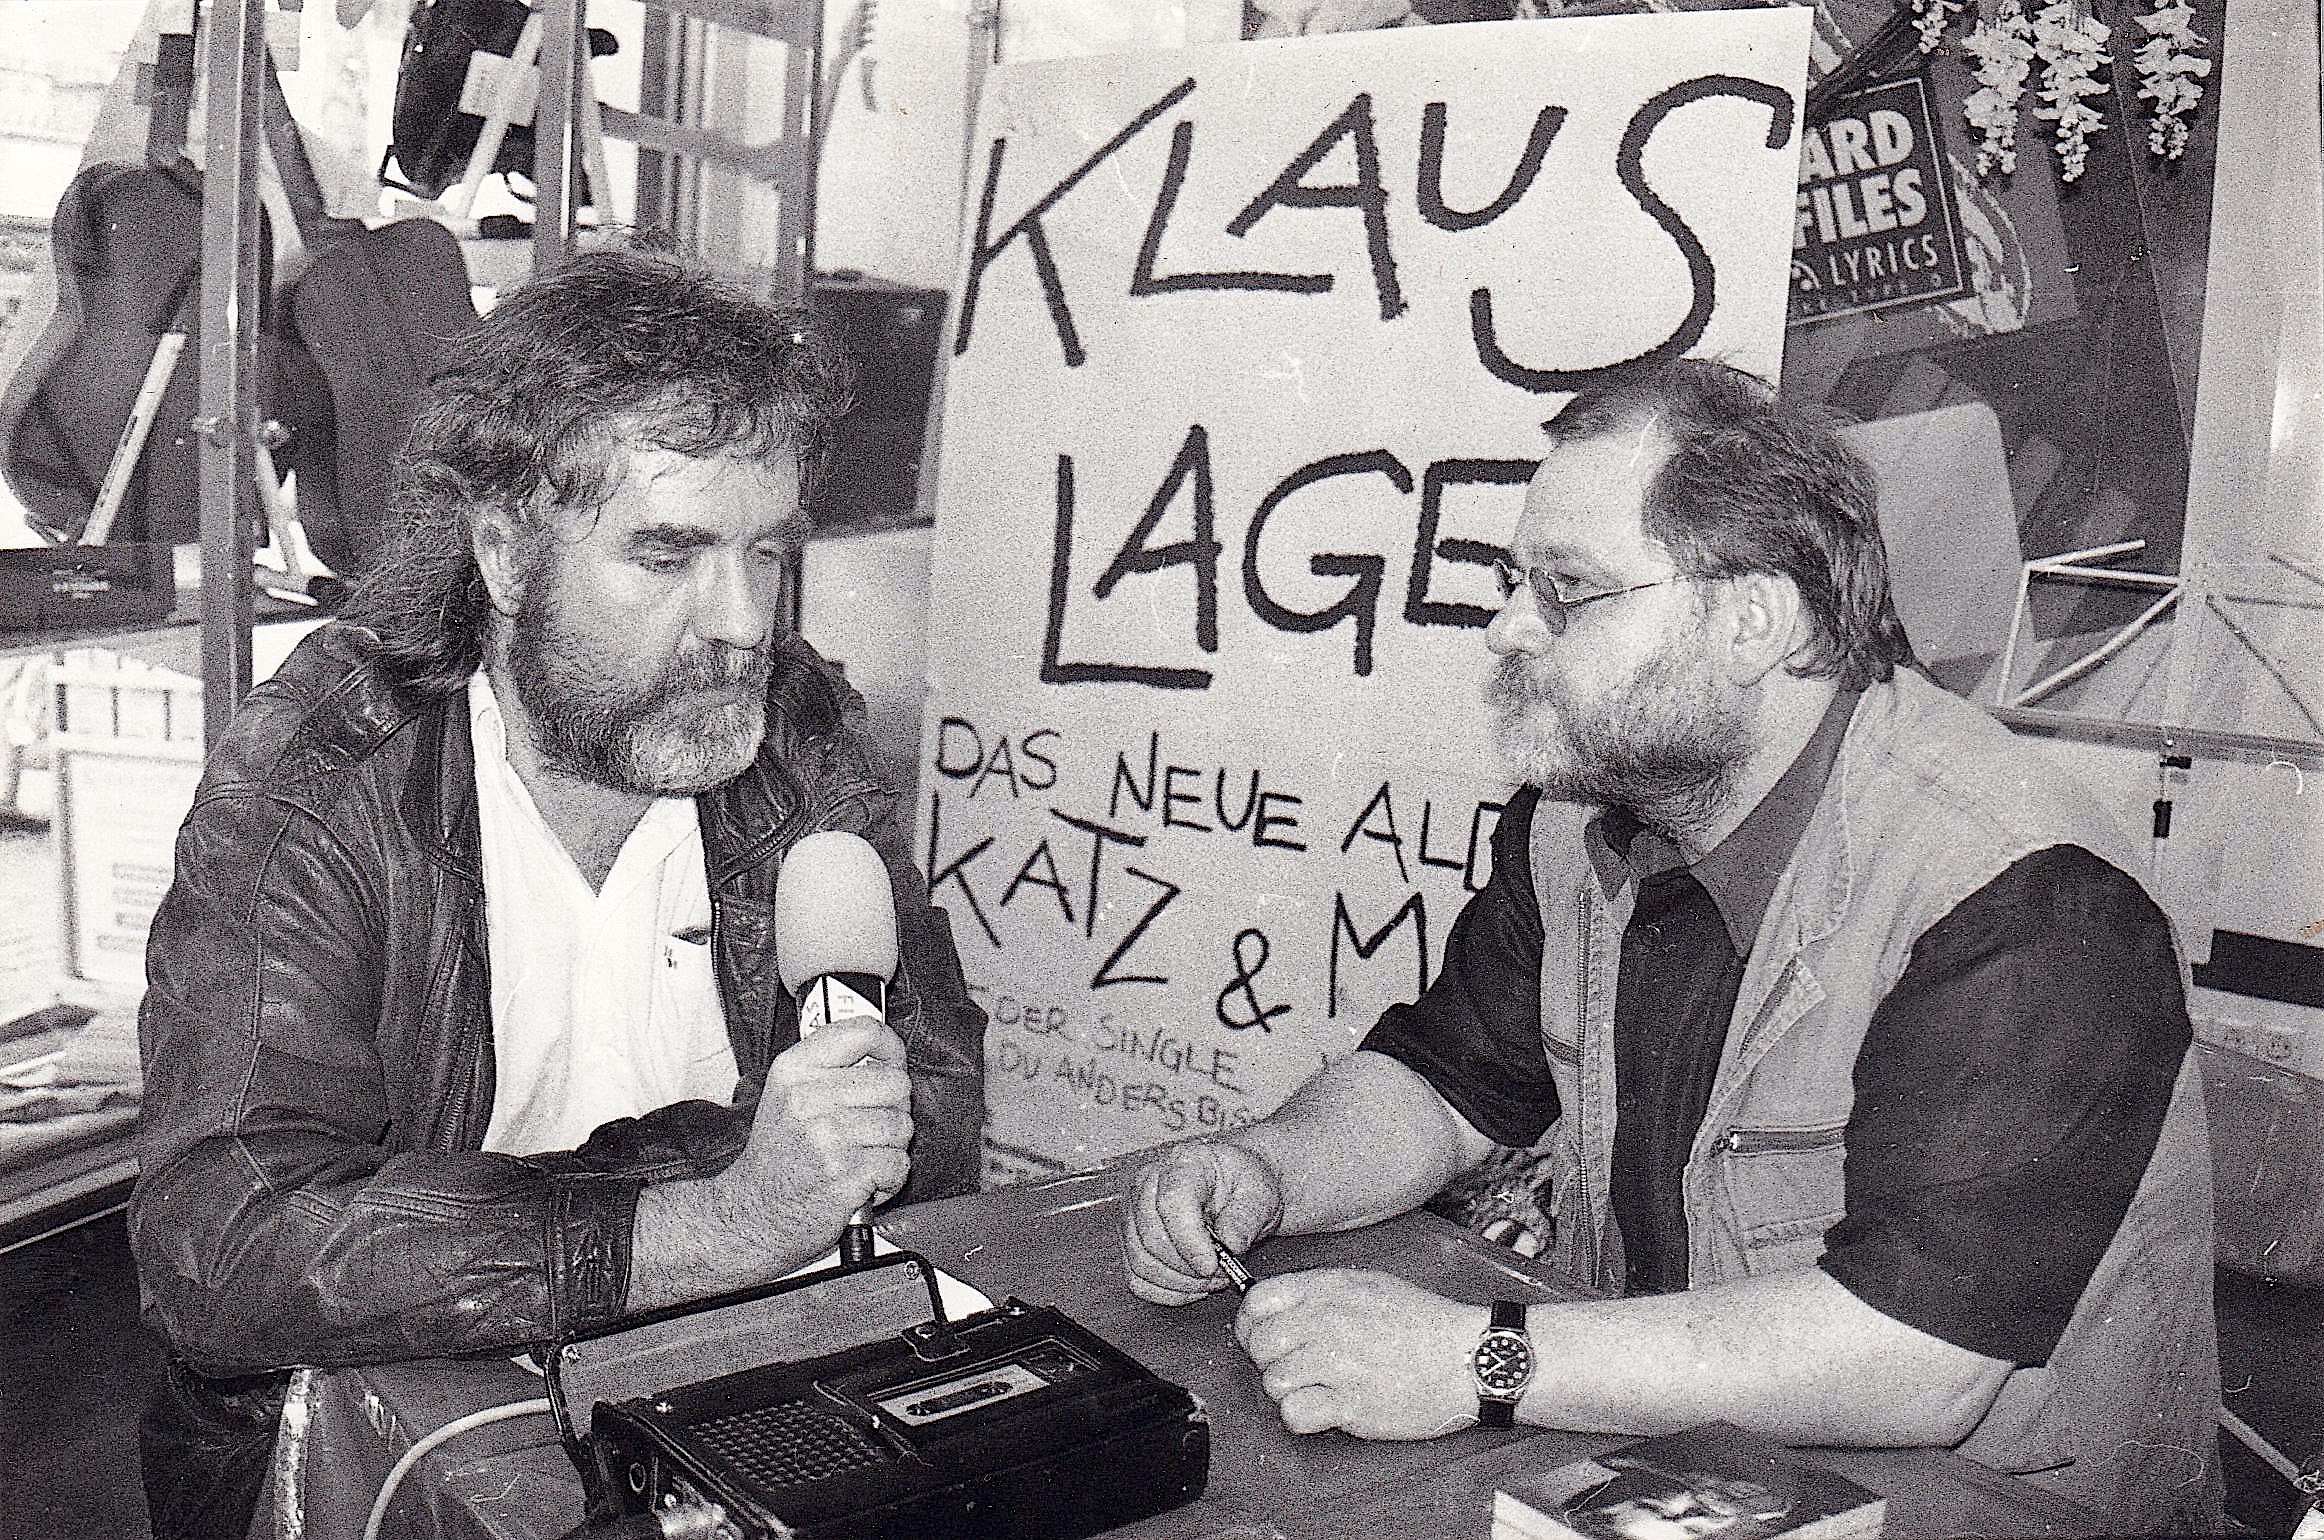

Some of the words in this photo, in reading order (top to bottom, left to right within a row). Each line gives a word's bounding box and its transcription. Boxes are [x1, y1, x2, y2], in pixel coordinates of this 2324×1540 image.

[955, 74, 1795, 393] KLAUS
[1829, 234, 1938, 288] LYRICS
[934, 716, 1063, 798] DAS
[1109, 731, 1306, 851] NEUE
[926, 789, 1182, 990] KATZ
[1215, 928, 1293, 1033] &
[1000, 1042, 1042, 1080] DU
[1054, 1056, 1188, 1131] ANDERS
[1094, 1013, 1245, 1094] SINGLE
